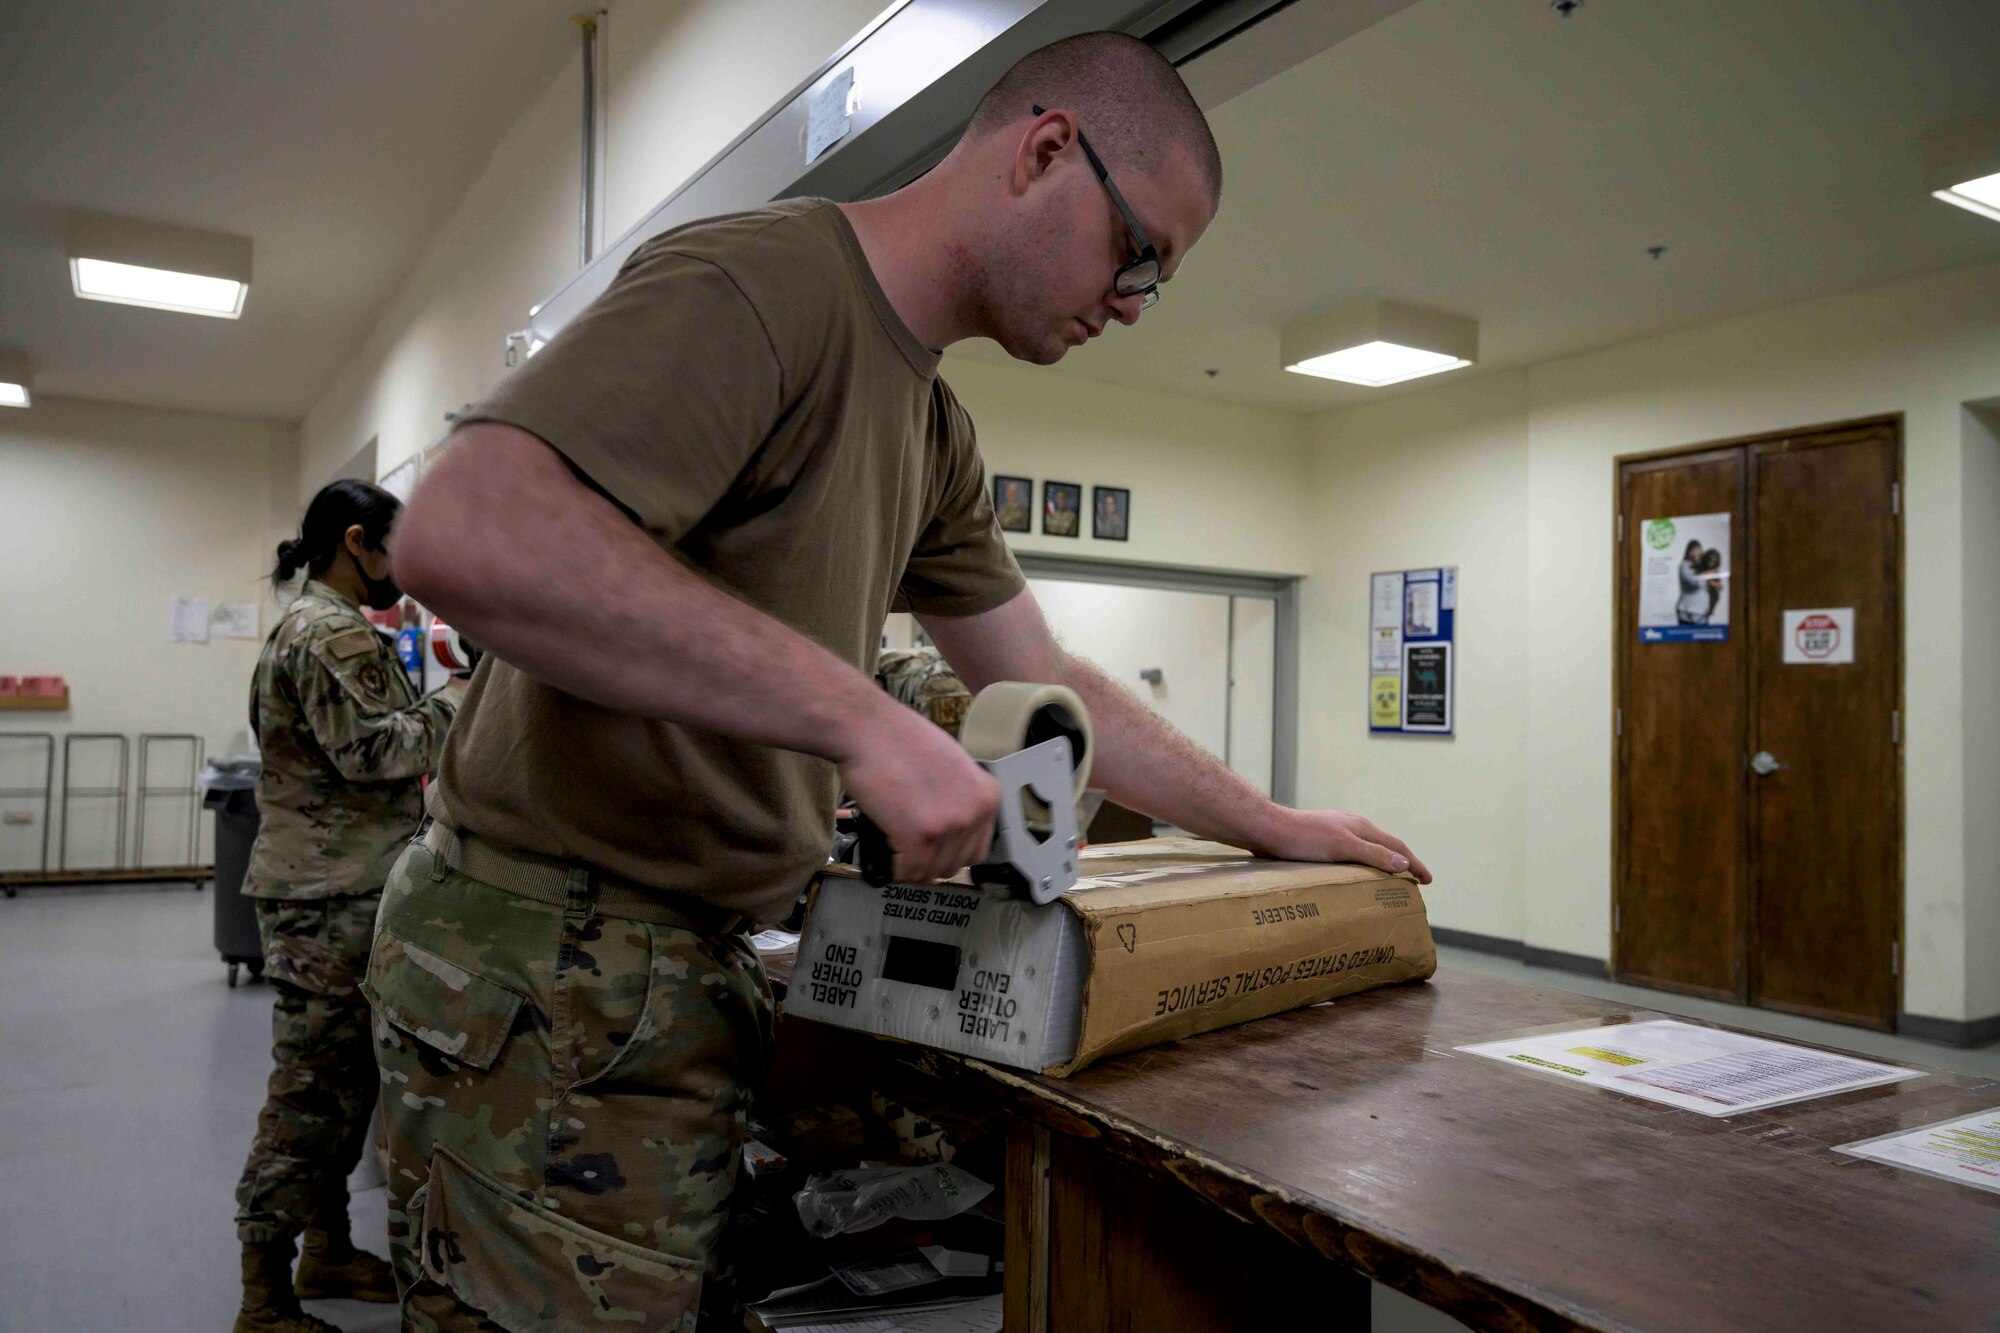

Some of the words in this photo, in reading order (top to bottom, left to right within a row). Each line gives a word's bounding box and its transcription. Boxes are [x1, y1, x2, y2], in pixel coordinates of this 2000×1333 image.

[882, 885, 931, 904] SERVICE
[934, 892, 980, 910] POSTAL
[883, 903, 927, 922] STATES
[928, 909, 970, 927] UNITED
[1251, 905, 1294, 926] SLEEVE
[825, 944, 857, 965] END
[1296, 953, 1349, 981] STATES
[1347, 945, 1396, 972] UNITED
[811, 962, 863, 987] OTHER
[974, 970, 1011, 994] END
[1233, 964, 1294, 996] POSTAL
[812, 982, 857, 1009] LABEL
[958, 990, 1017, 1018] OTHER
[1154, 975, 1232, 1017] SERVICE
[957, 1012, 1010, 1043] LABEL
